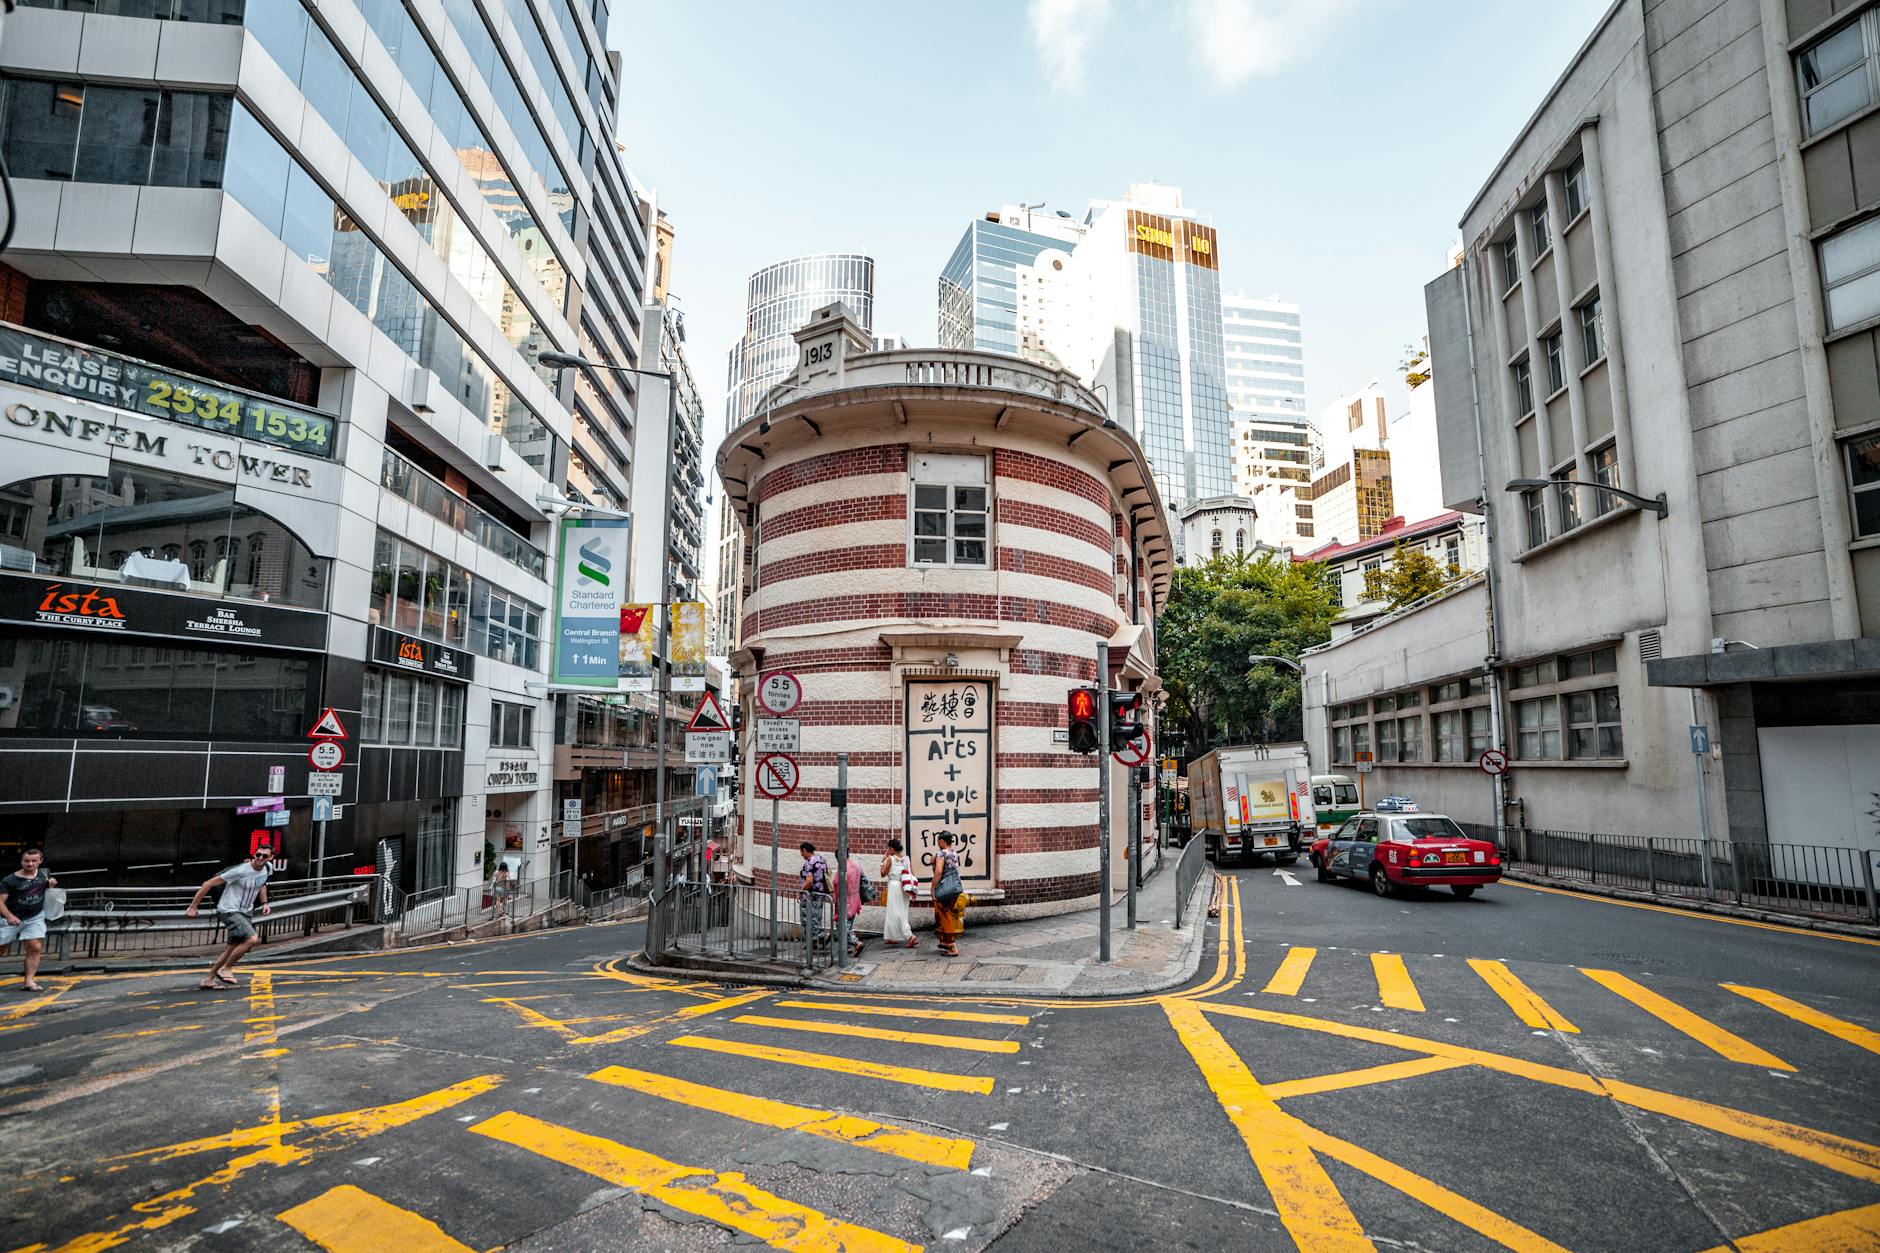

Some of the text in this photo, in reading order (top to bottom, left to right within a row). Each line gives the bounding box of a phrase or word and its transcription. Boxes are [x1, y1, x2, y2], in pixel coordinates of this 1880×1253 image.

[1136, 224, 1210, 255] SHUN HO
[804, 342, 833, 367] 1913
[22, 343, 119, 382] LEASE
[0, 355, 137, 409] ENQUIRY
[146, 379, 327, 446] 2534 1534
[6, 403, 313, 488] ONFEM TOWER
[571, 590, 614, 600] Standard
[569, 601, 615, 610] Chartered
[39, 613, 123, 628] THE CURRY PLACE
[206, 616, 244, 627] SHEESHA
[216, 610, 236, 619] BAR
[187, 620, 262, 635] TERRACE LOUNGE
[564, 628, 618, 637] Central Branch
[570, 637, 601, 646] Wellington
[771, 678, 790, 691] 5.5
[768, 691, 791, 699] tonnes
[318, 746, 336, 755] 5.5
[927, 739, 977, 761] Arts
